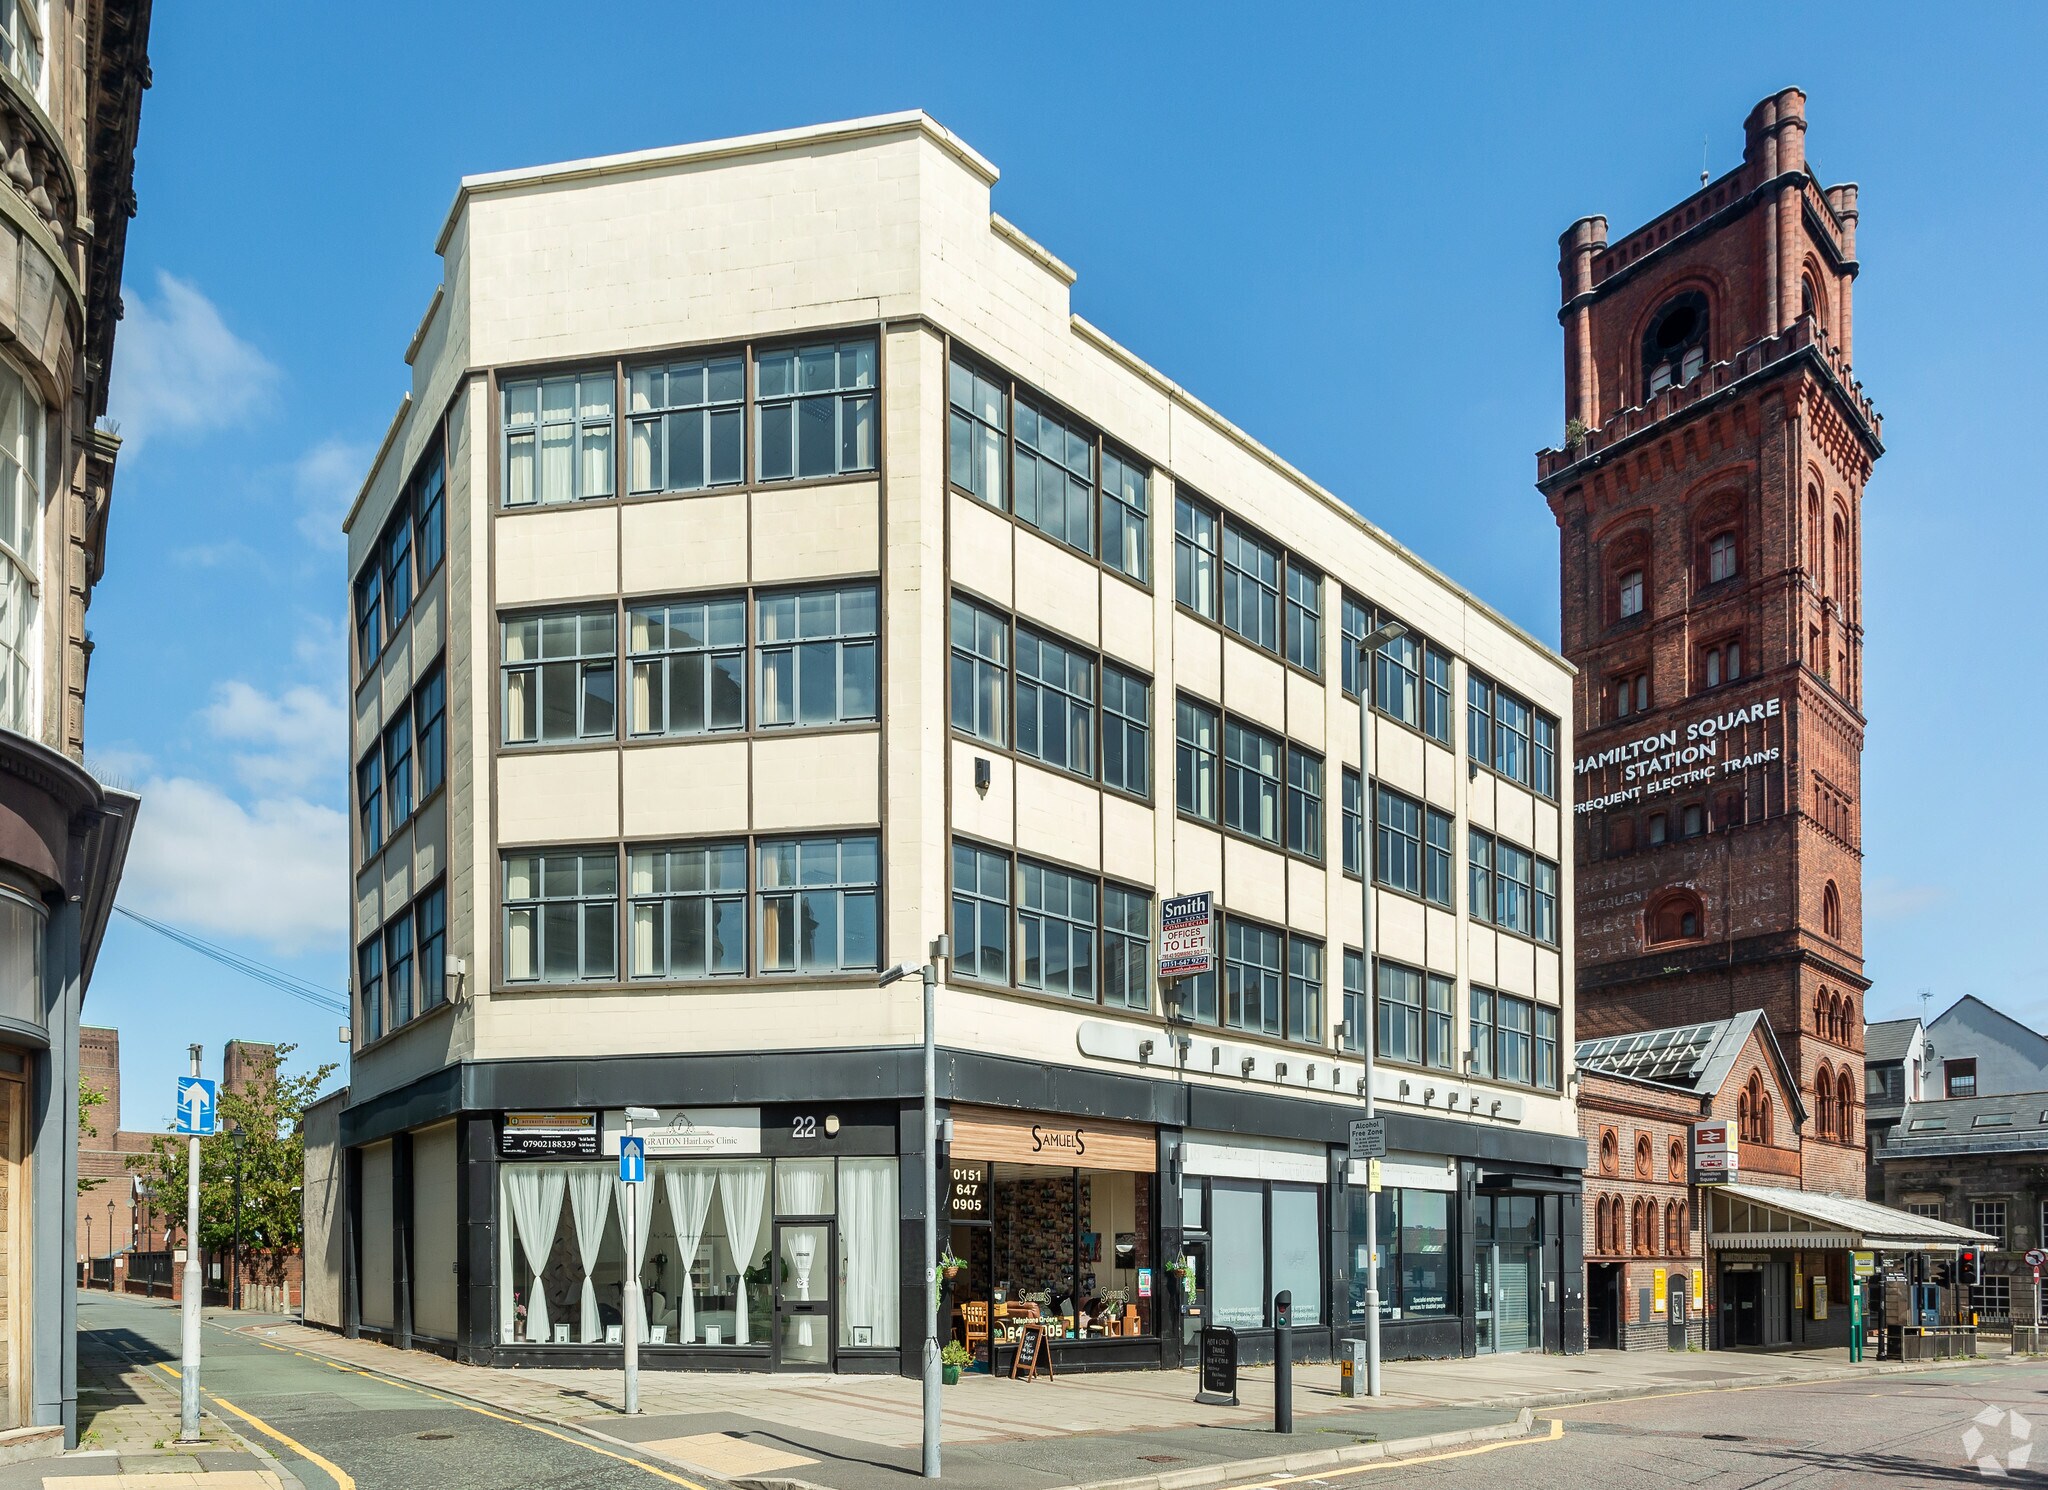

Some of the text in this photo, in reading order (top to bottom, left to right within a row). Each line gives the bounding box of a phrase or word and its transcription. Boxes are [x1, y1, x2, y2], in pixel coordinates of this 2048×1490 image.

[1574, 698, 1780, 775] HAMILTON SQUARE
[1625, 740, 1717, 781] STATION
[1574, 748, 1780, 814] FREQUENT ELECTRIC TRAINS
[1165, 897, 1206, 918] Smith
[1164, 920, 1206, 931] COMMERCIAL
[1167, 928, 1201, 940] OFFICES
[1163, 936, 1206, 952] TO LET
[792, 1116, 816, 1138] 22
[1355, 1121, 1380, 1130] Alcohol
[522, 1140, 577, 1148] 07902188339
[645, 1136, 738, 1146] GRATION HairLoss Clinic
[953, 1169, 981, 1181] 0151
[956, 1184, 978, 1196] 647
[952, 1199, 982, 1211] 0905
[1012, 1315, 1058, 1325] Telephone Orders
[1007, 1326, 1024, 1340] 64
[1343, 1361, 1353, 1376] H
